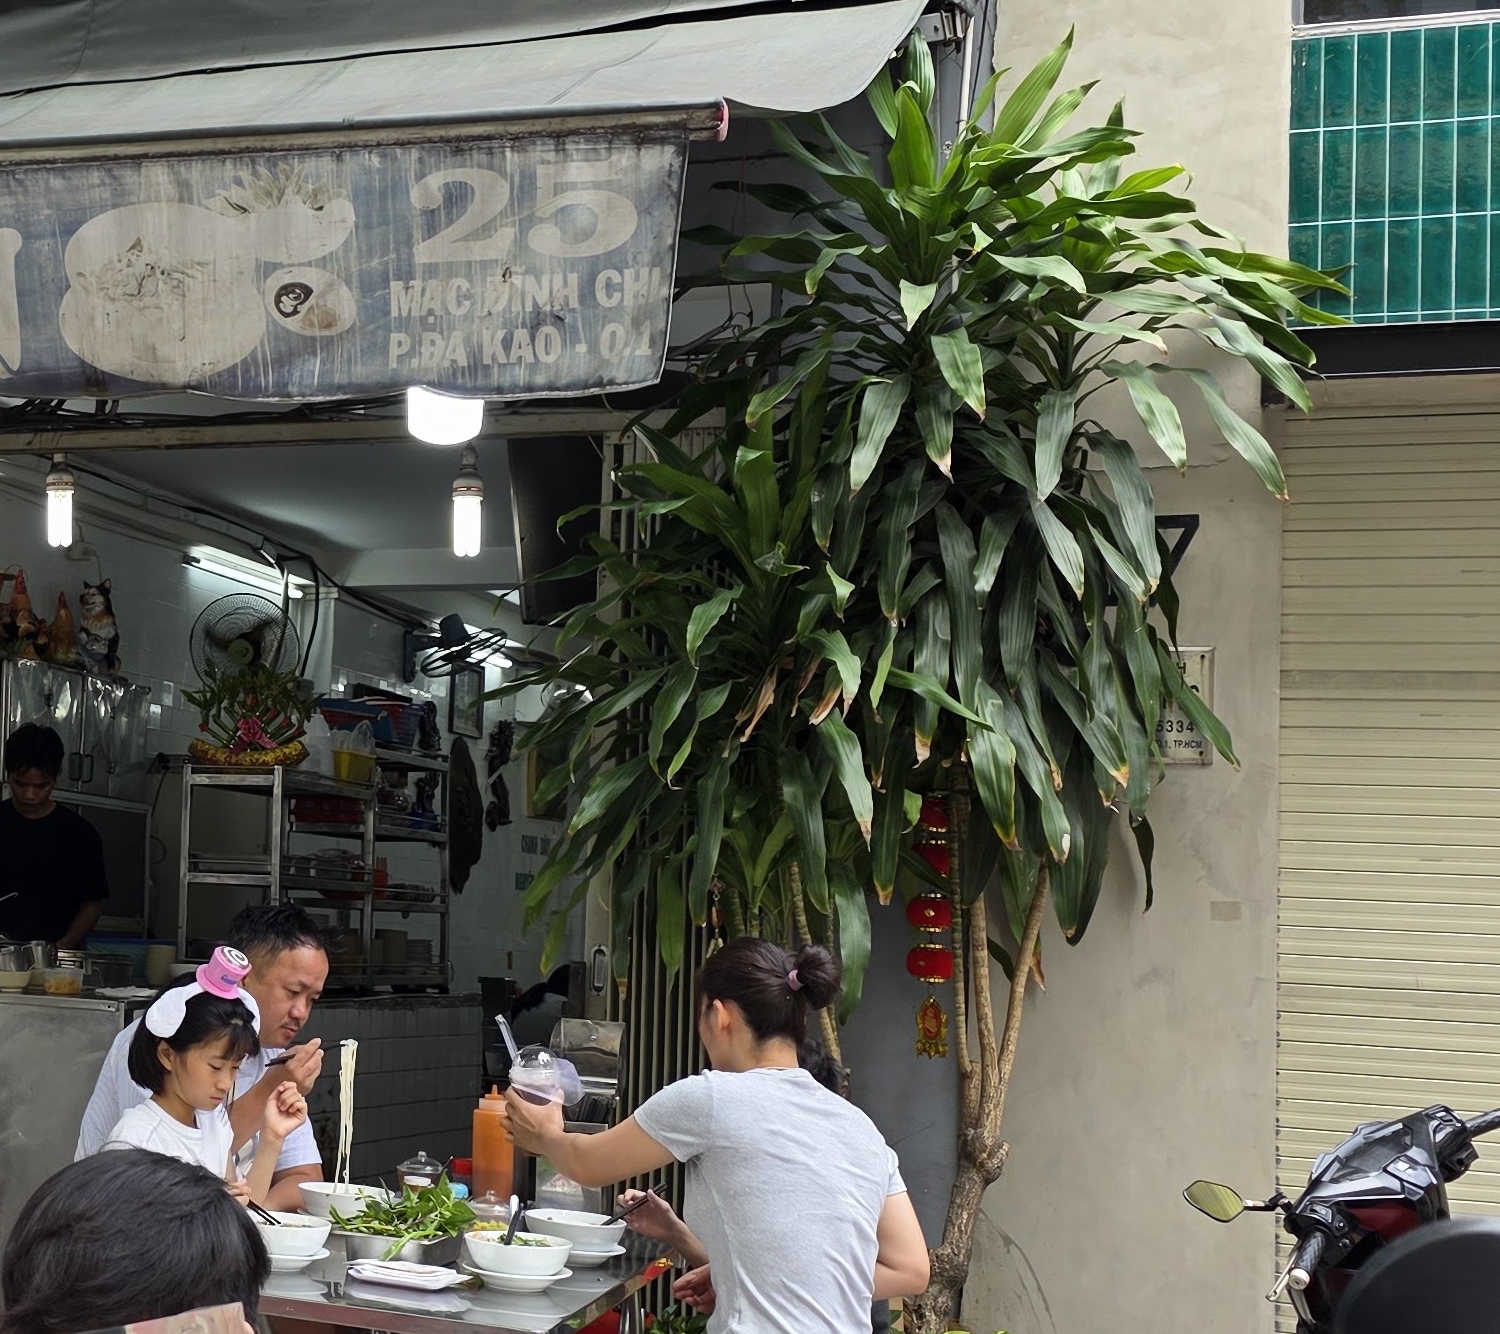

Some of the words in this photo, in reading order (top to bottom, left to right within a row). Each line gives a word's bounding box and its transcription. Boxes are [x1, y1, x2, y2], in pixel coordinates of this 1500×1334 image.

[411, 153, 638, 264] 25
[390, 277, 471, 324] MẠC
[595, 267, 661, 308] CHI
[482, 322, 562, 365] KAO
[600, 322, 653, 361] Q.1
